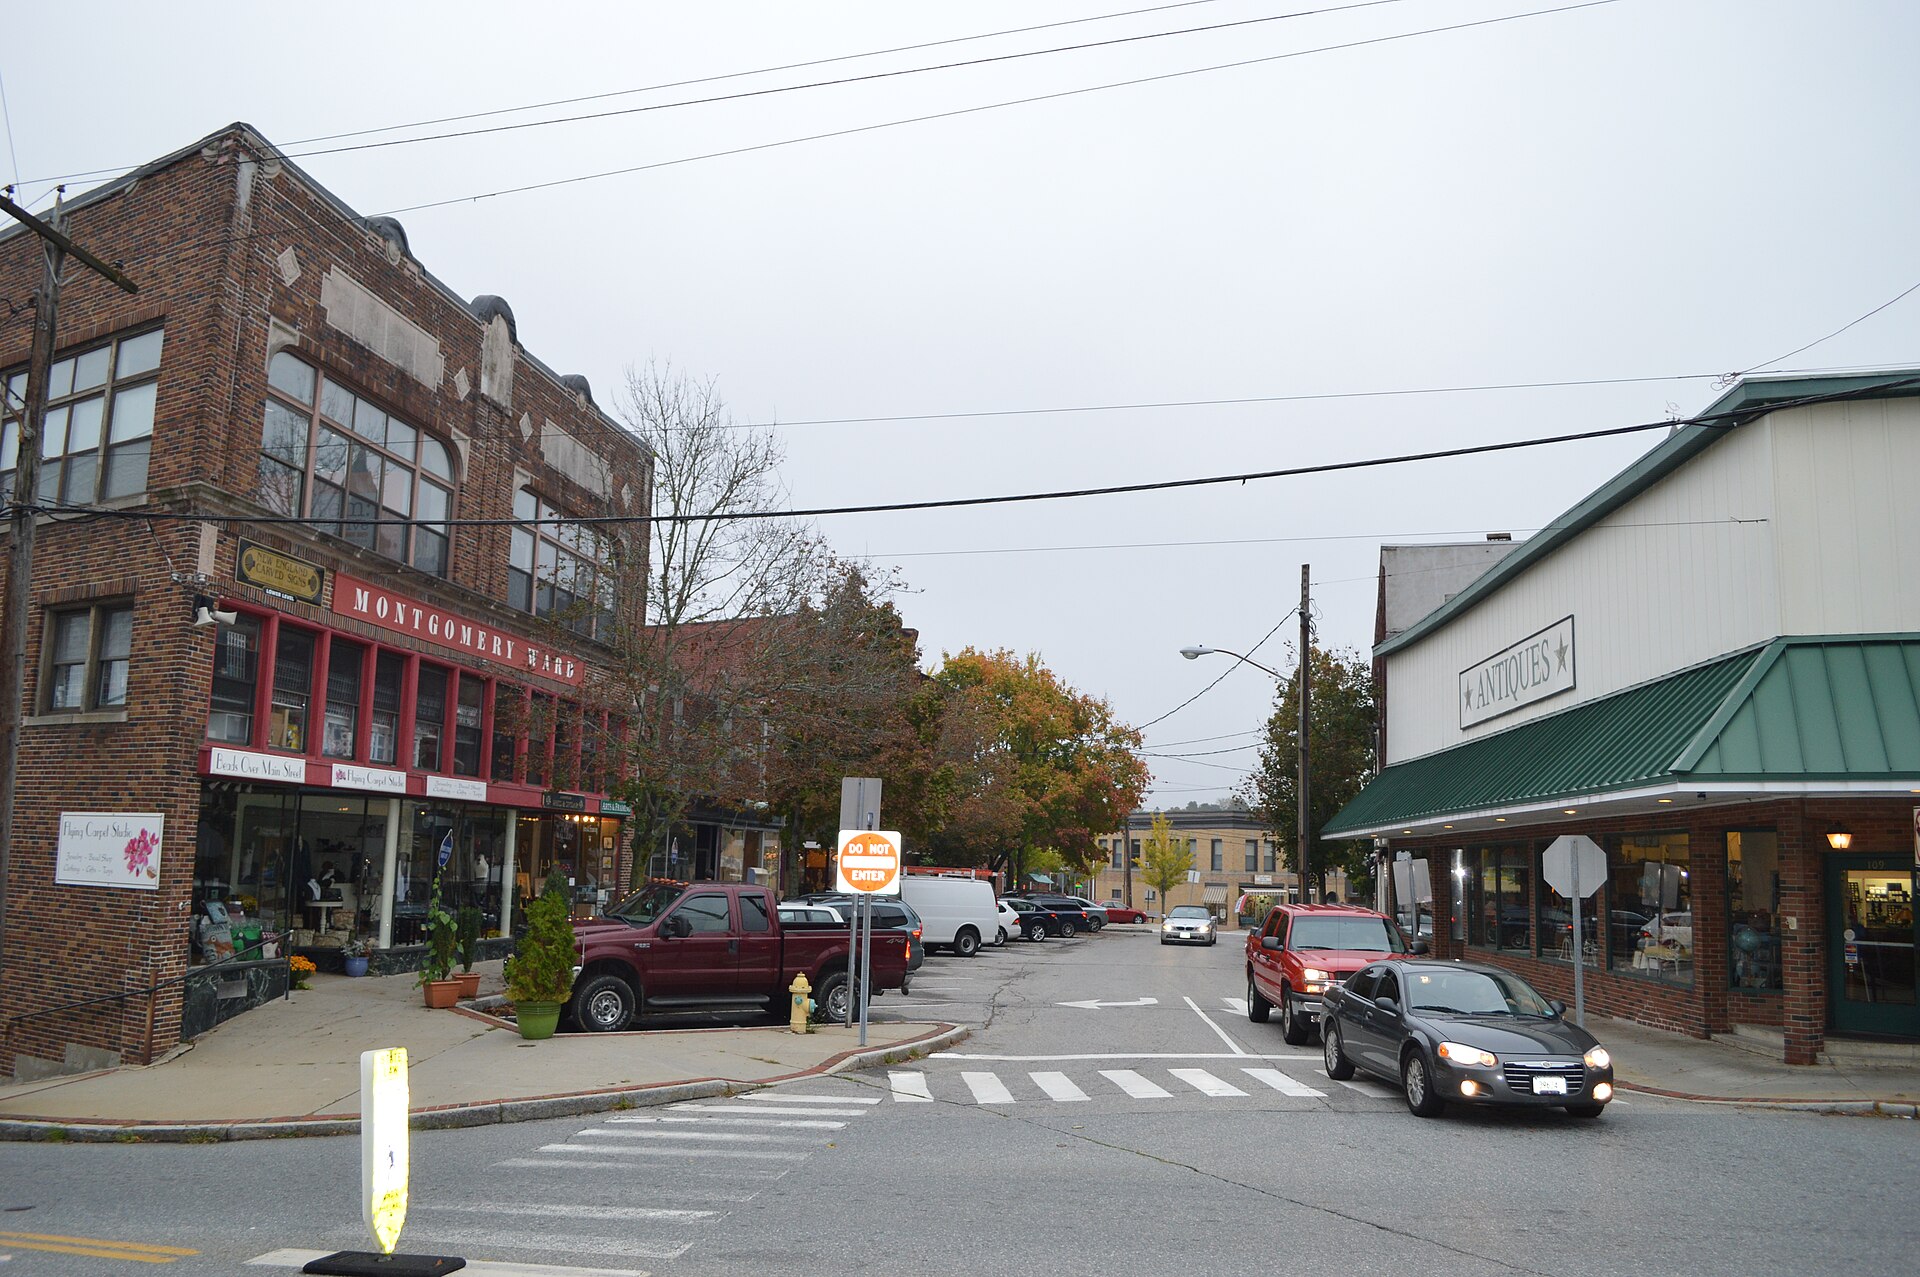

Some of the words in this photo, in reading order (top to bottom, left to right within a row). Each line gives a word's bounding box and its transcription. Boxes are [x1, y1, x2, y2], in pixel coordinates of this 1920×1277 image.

[257, 552, 272, 565] NEW
[275, 559, 307, 576] ENGLAND
[256, 563, 284, 580] CARVED
[287, 573, 306, 587] SIGNS
[265, 588, 281, 596] LOWER
[281, 592, 295, 602] LEVEL
[353, 588, 515, 660] MONTGOMERY
[528, 647, 574, 679] WARD
[1477, 639, 1551, 709] ANTIQUES
[216, 753, 238, 771] Beads
[240, 756, 259, 774] Over
[262, 759, 281, 777] Main
[283, 762, 302, 779] Street
[347, 768, 366, 785] Flying
[366, 772, 387, 788] Carpet
[388, 776, 404, 788] Studio
[63, 821, 84, 839] Flying
[85, 821, 109, 840] Carpet
[111, 822, 132, 837] Studio
[848, 843, 863, 854] DO
[869, 843, 890, 855] NOT
[1867, 860, 1885, 869] 109
[851, 870, 886, 881] ENTER
